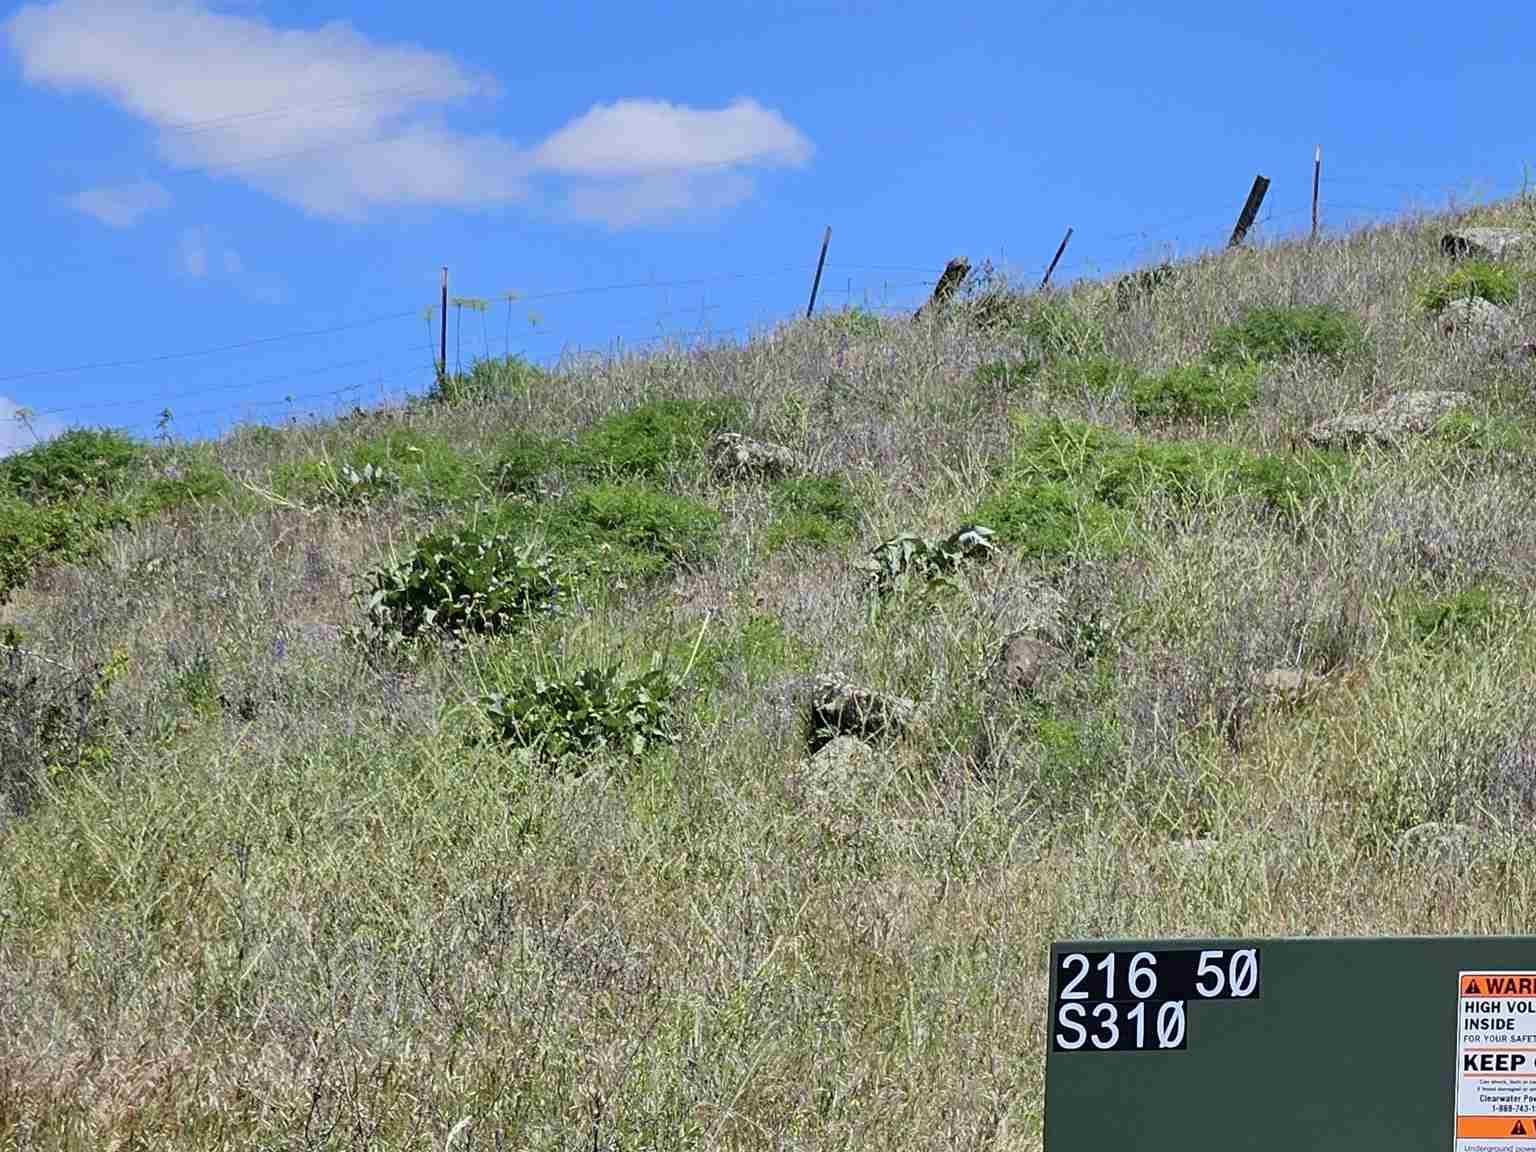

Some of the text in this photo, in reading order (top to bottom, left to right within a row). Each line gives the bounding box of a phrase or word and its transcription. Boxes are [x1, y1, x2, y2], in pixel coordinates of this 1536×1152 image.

[1060, 948, 1258, 1000] 216 50
[1464, 1001, 1501, 1013] HIGH
[1056, 1000, 1186, 1049] S310
[1464, 1018, 1516, 1030] INSIDE
[1463, 1054, 1526, 1072] KEEP
[1479, 1094, 1521, 1103] Clearwater
